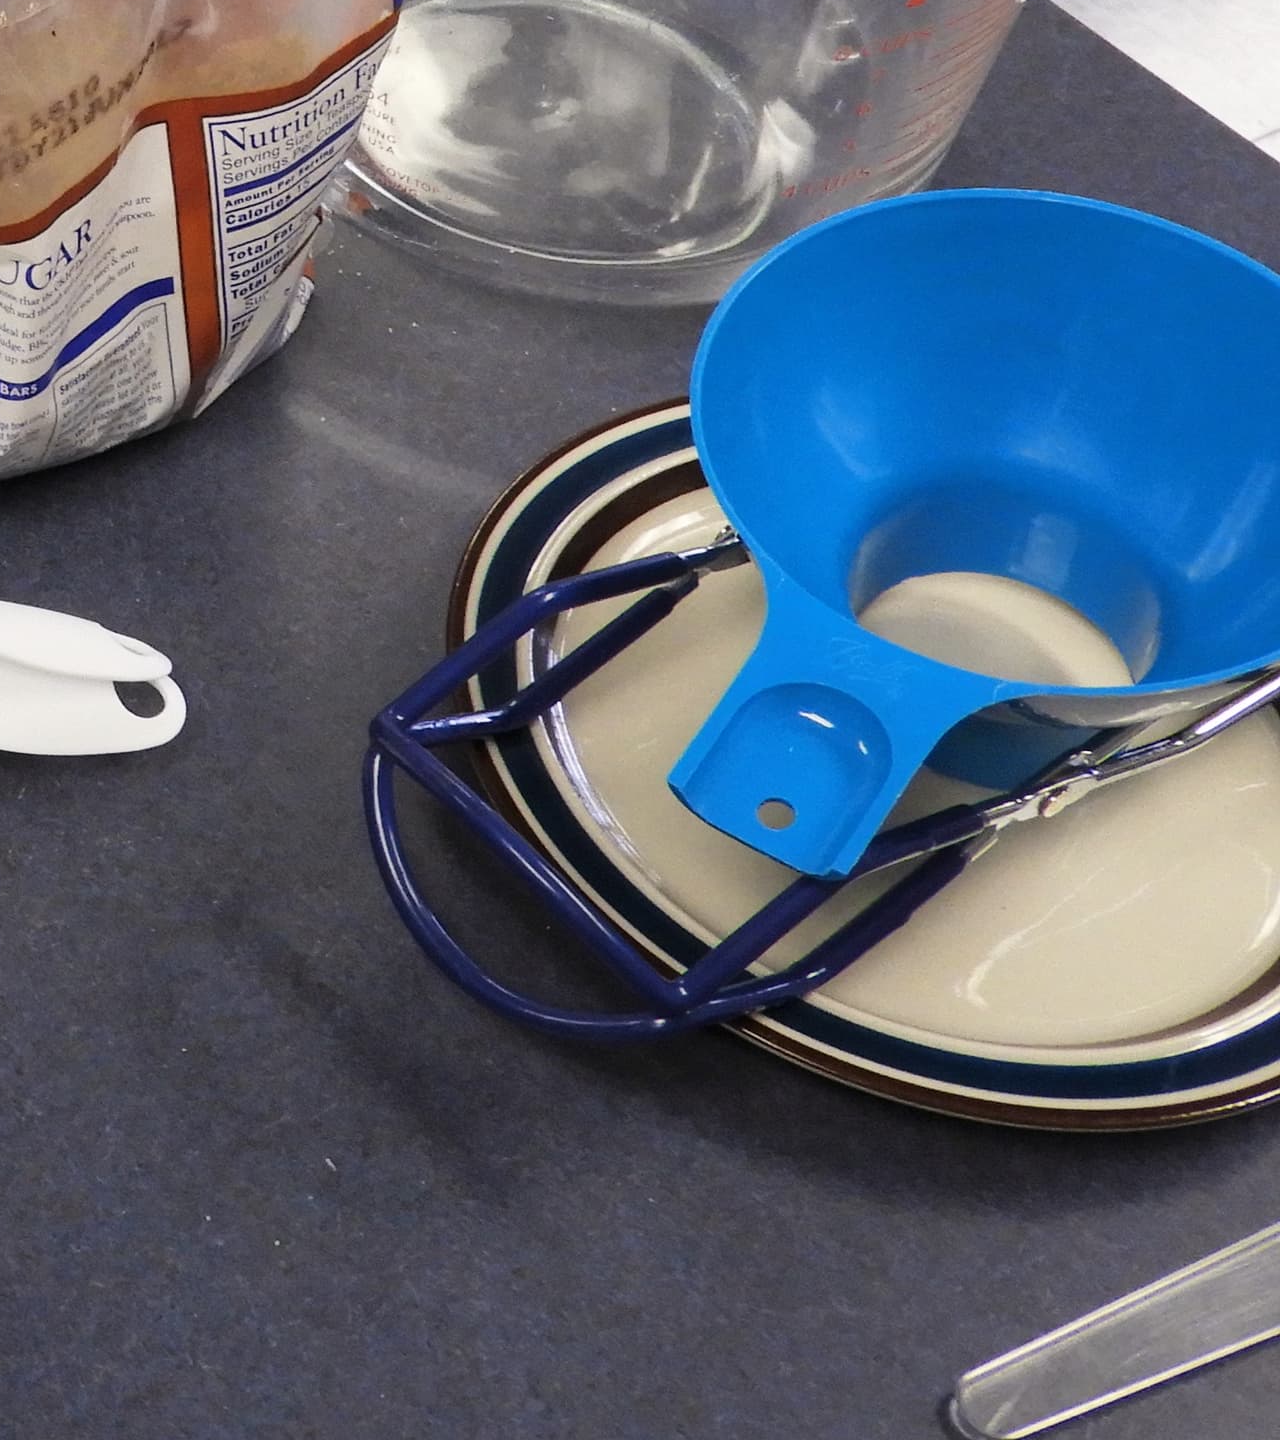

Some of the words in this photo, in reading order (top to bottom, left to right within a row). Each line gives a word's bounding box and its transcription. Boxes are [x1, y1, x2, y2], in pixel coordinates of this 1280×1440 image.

[219, 88, 346, 157] Nutrition
[222, 145, 280, 171] Serving
[285, 129, 313, 151] Size
[223, 159, 289, 185] Servings
[292, 141, 313, 160] Per
[225, 187, 274, 208] Amount
[277, 174, 295, 190] Per
[225, 195, 292, 225] Calories
[228, 240, 268, 262] Total
[273, 223, 293, 243] Fat
[230, 248, 284, 281] Sodium
[231, 274, 267, 299] Total
[0, 384, 38, 398] BARS
